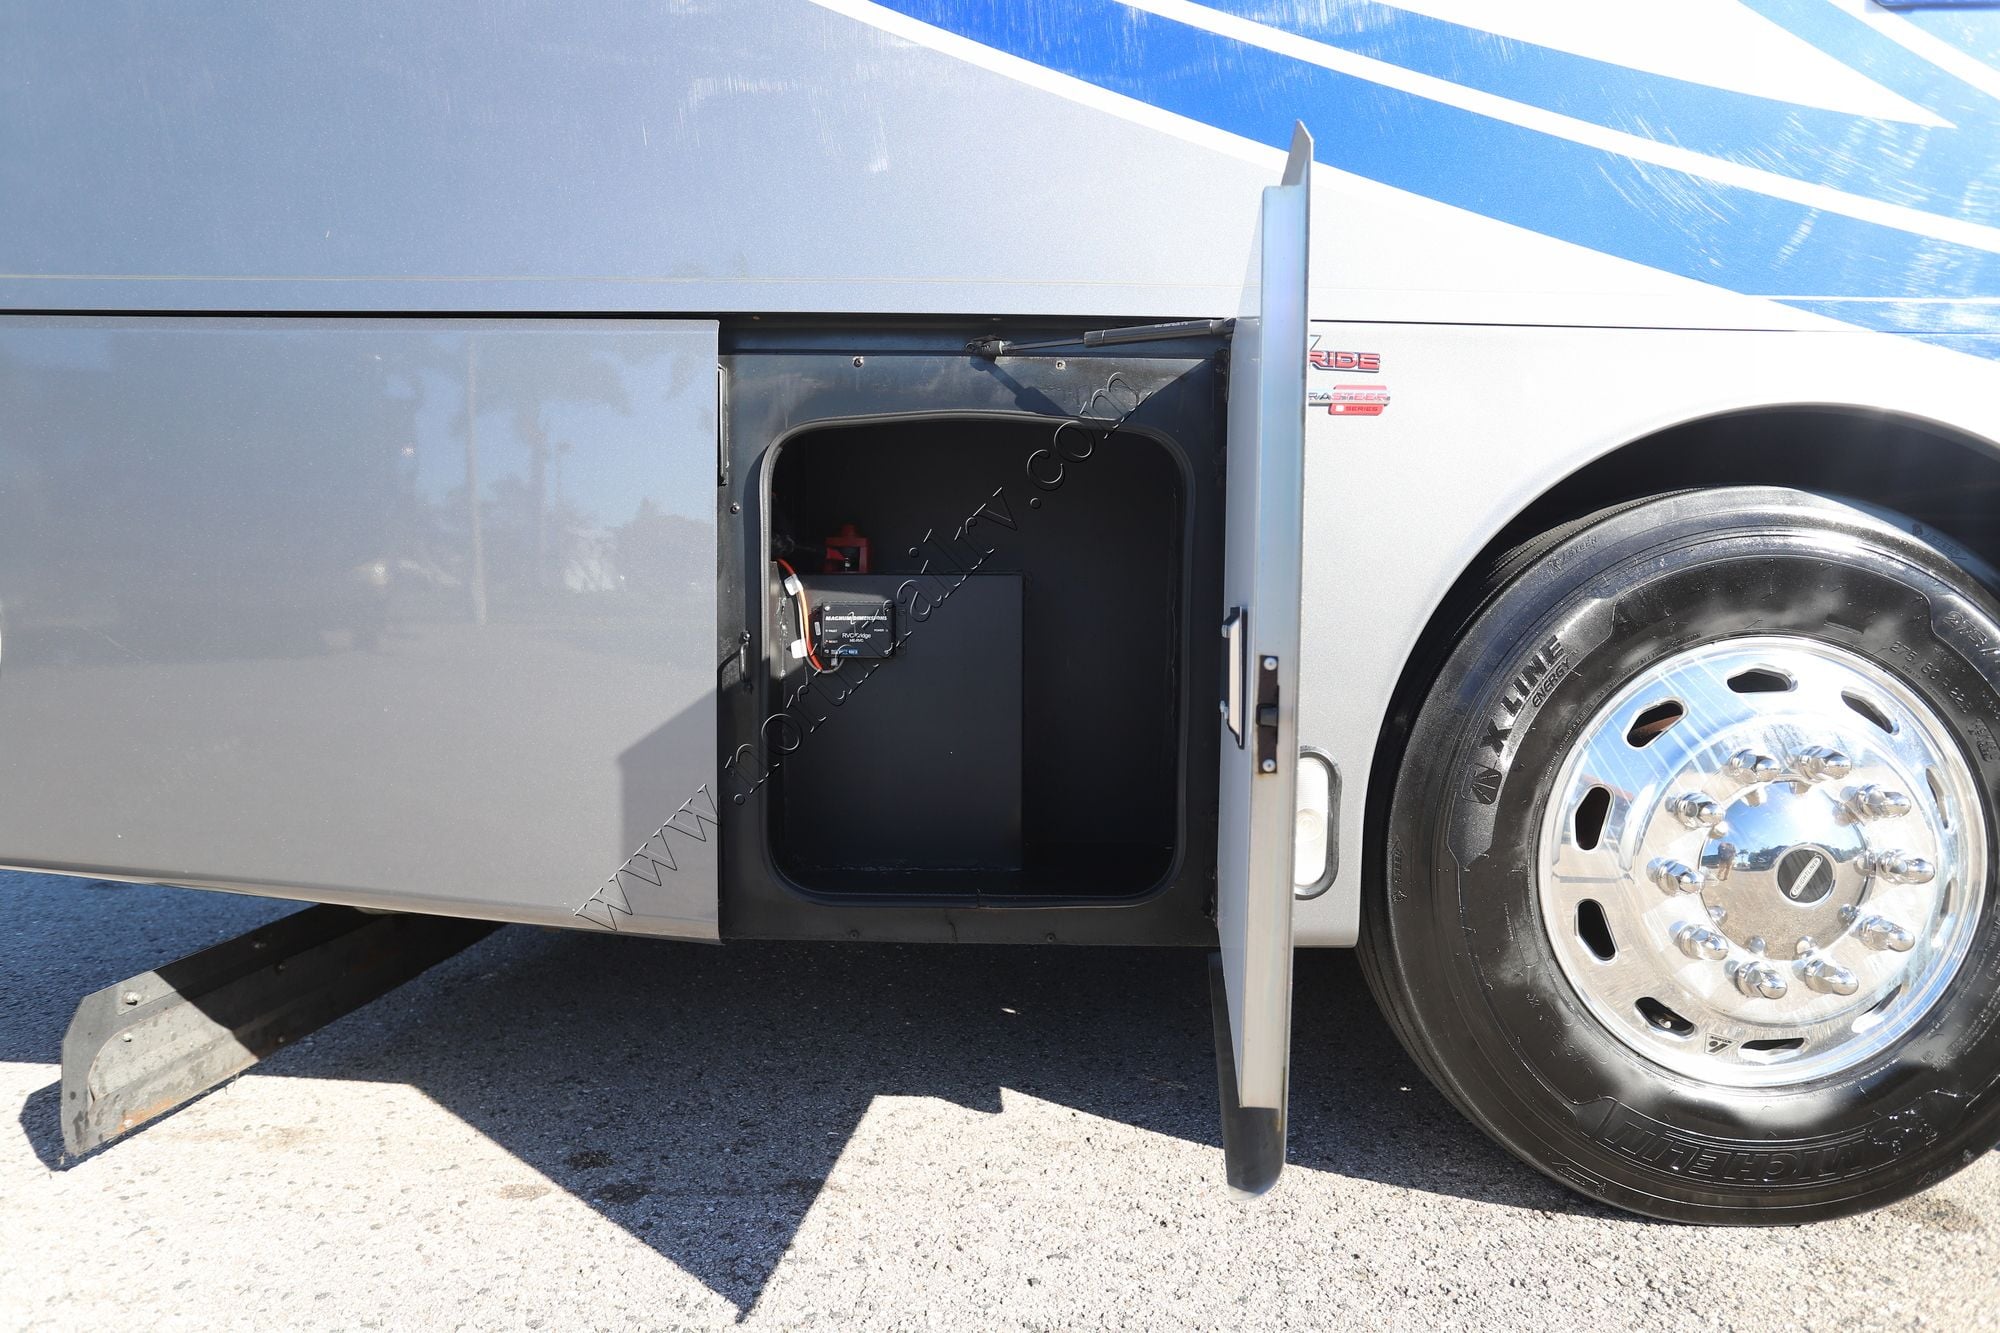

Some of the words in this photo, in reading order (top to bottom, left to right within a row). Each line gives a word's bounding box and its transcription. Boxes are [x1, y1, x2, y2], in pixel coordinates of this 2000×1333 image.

[1500, 635, 1564, 718] LINE
[1531, 657, 1571, 708] ENERGY
[1603, 1120, 1866, 1182] MICHELIN
